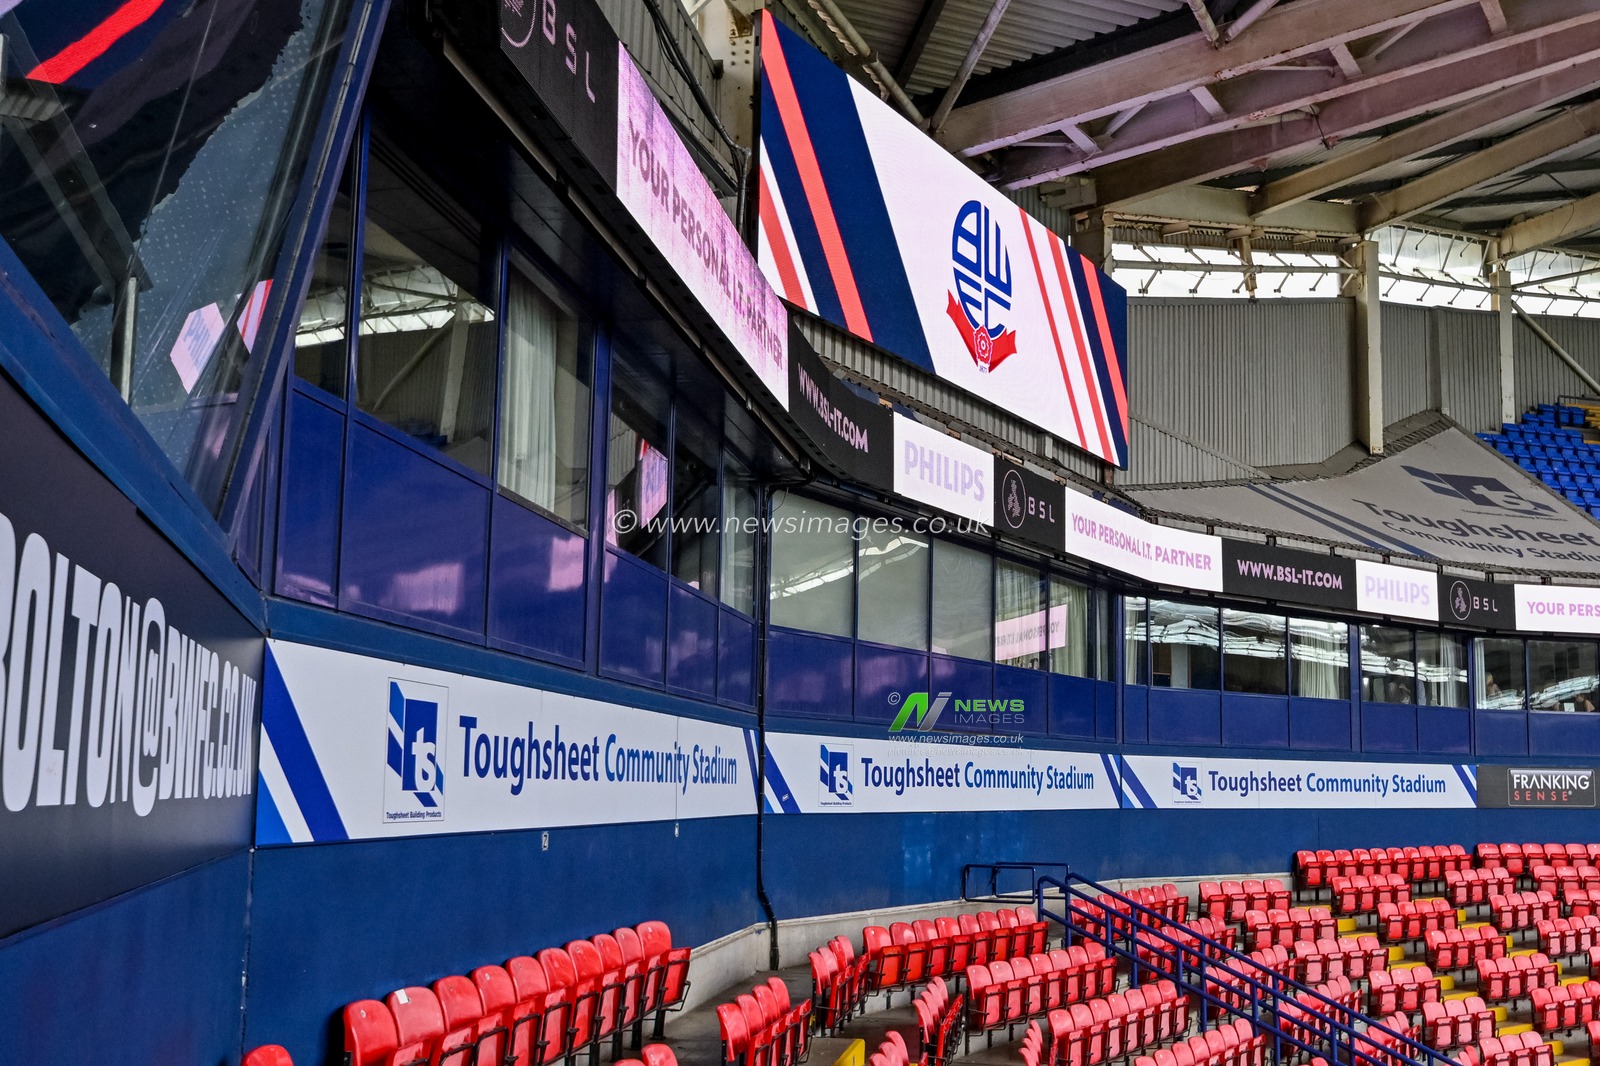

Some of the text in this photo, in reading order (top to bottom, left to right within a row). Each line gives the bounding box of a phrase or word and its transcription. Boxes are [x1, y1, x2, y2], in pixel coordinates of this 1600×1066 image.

[542, 0, 596, 104] BSL
[629, 118, 670, 213] YOUR
[672, 184, 731, 301] PERSONAL
[746, 294, 784, 371] PARTNER
[904, 439, 986, 502] PHILIPS
[1028, 496, 1056, 523] BSL
[1351, 498, 1600, 547] Toughsheet
[1071, 512, 1212, 570] YOUR PERSONAL I.T. PARTNER
[1382, 521, 1524, 558] Community
[1237, 559, 1343, 590] WWW.BSL-IT.COM
[1365, 575, 1430, 606] PHILIPS
[1473, 596, 1498, 612] BSL
[1526, 601, 1565, 616] YOUR
[459, 714, 737, 796] Toughsheet Community Stadium
[861, 757, 1094, 796] Toughsheet Community Stadium
[1208, 770, 1446, 798] Toughsheet Community Stadium
[1513, 774, 1590, 790] FRANKING
